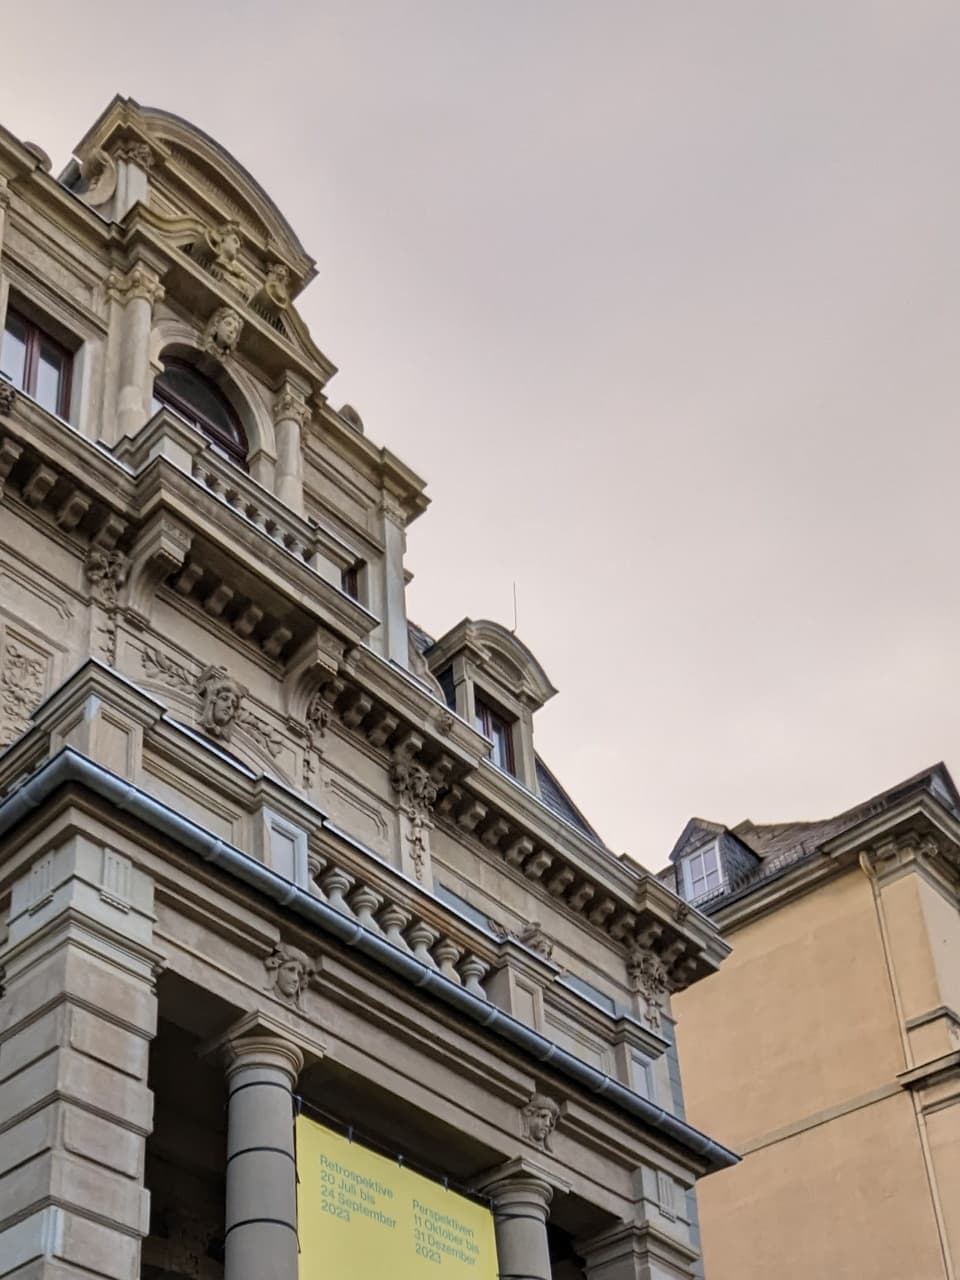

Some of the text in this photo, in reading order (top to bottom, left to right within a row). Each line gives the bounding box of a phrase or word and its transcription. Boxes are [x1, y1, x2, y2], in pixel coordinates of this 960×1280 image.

[320, 1154, 394, 1199] Retrospektive
[320, 1169, 376, 1206] 20 Juli bis
[320, 1185, 397, 1229] 24 September
[321, 1200, 351, 1222] 2023
[412, 1199, 474, 1238] Perspektiven
[414, 1214, 480, 1254] 11 Oktober bis
[414, 1228, 476, 1265] 31 Dezember
[415, 1244, 442, 1264] 2023
